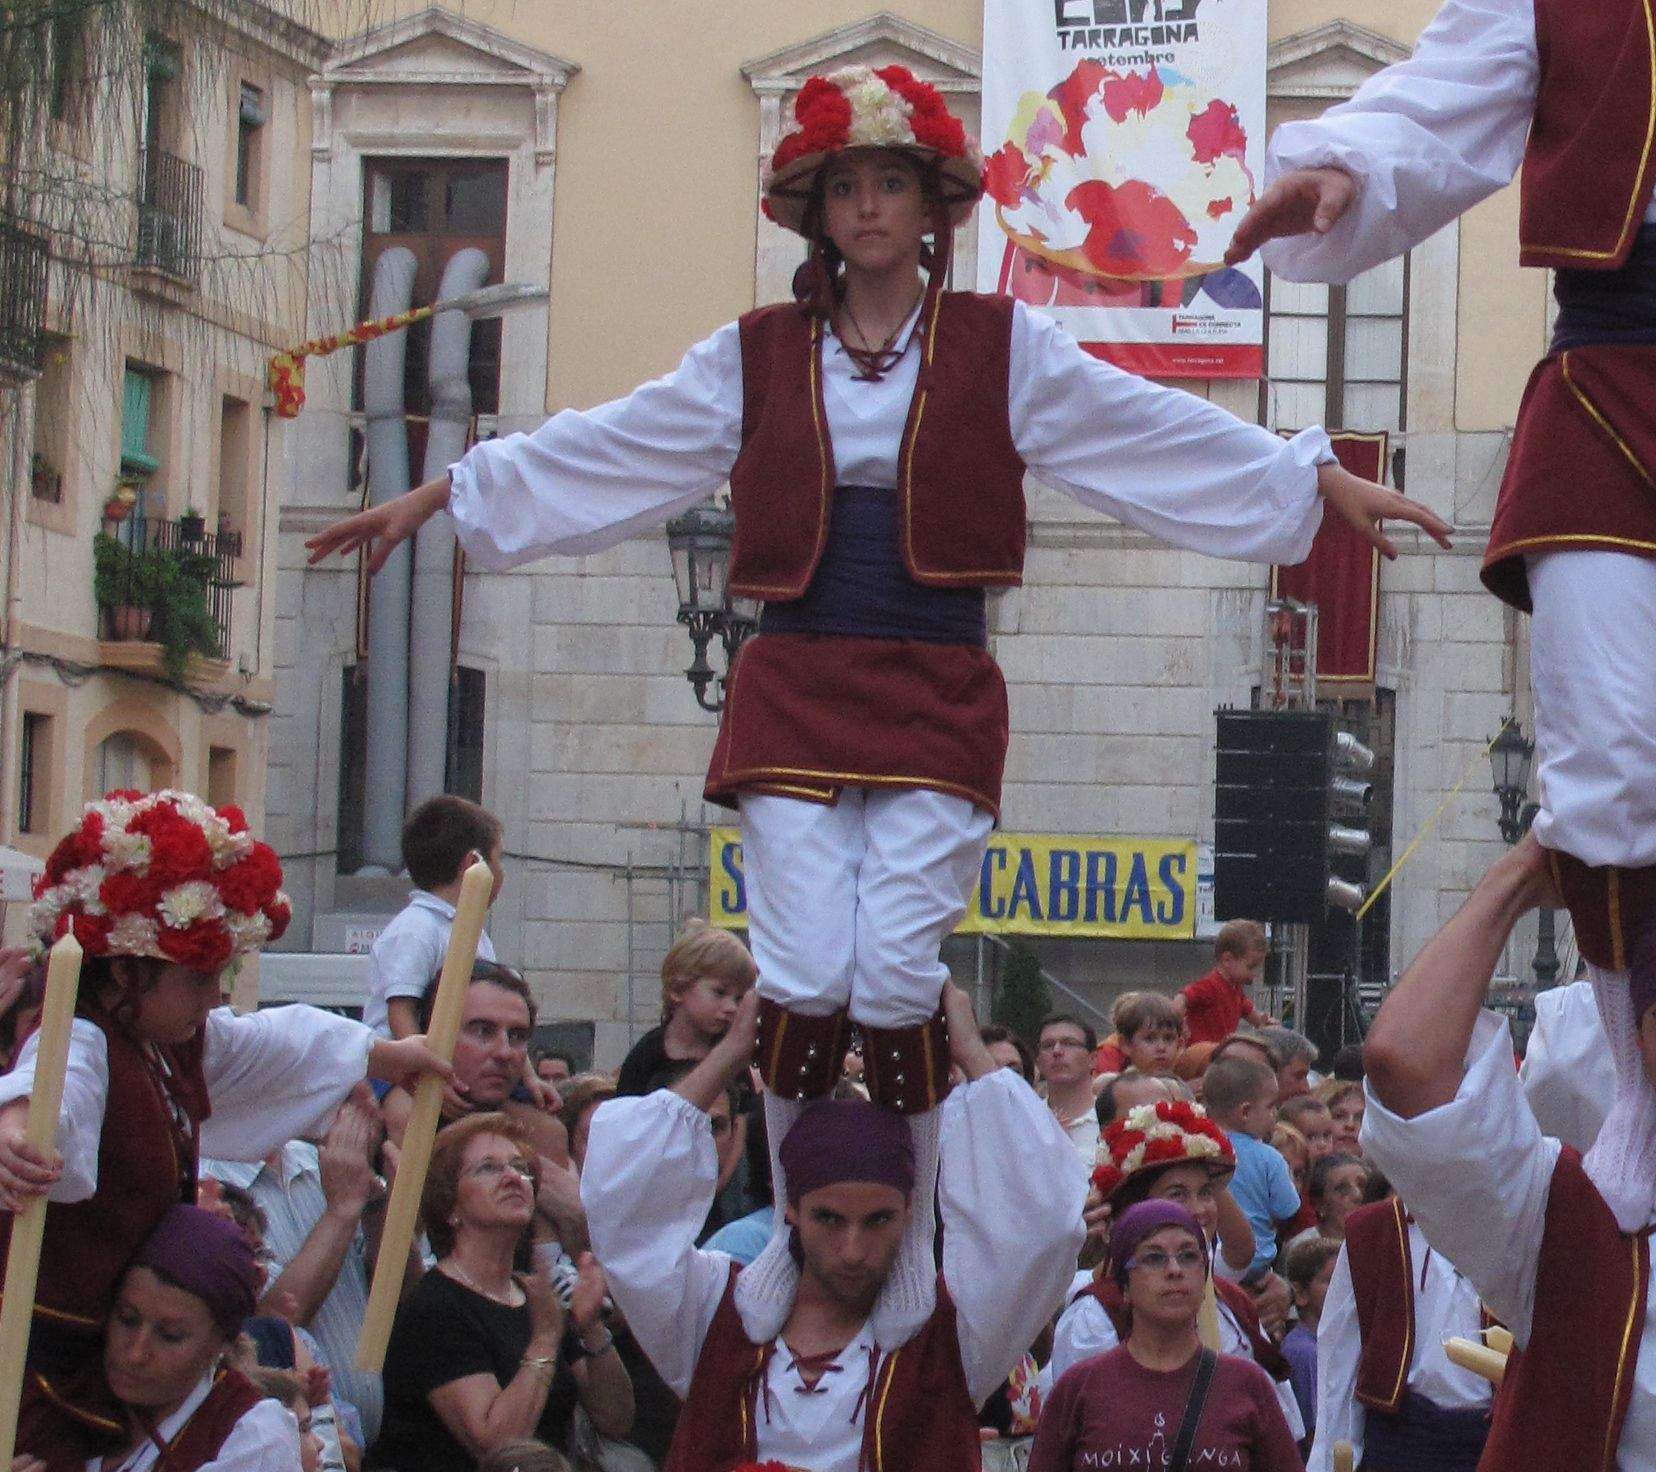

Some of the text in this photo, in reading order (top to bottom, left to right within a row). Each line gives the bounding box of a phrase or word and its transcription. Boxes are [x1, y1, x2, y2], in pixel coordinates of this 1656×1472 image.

[1056, 23, 1200, 50] TARRAGONA
[979, 847, 1187, 925] CABRAS
[1081, 1443, 1242, 1468] MOIXIGNGA
